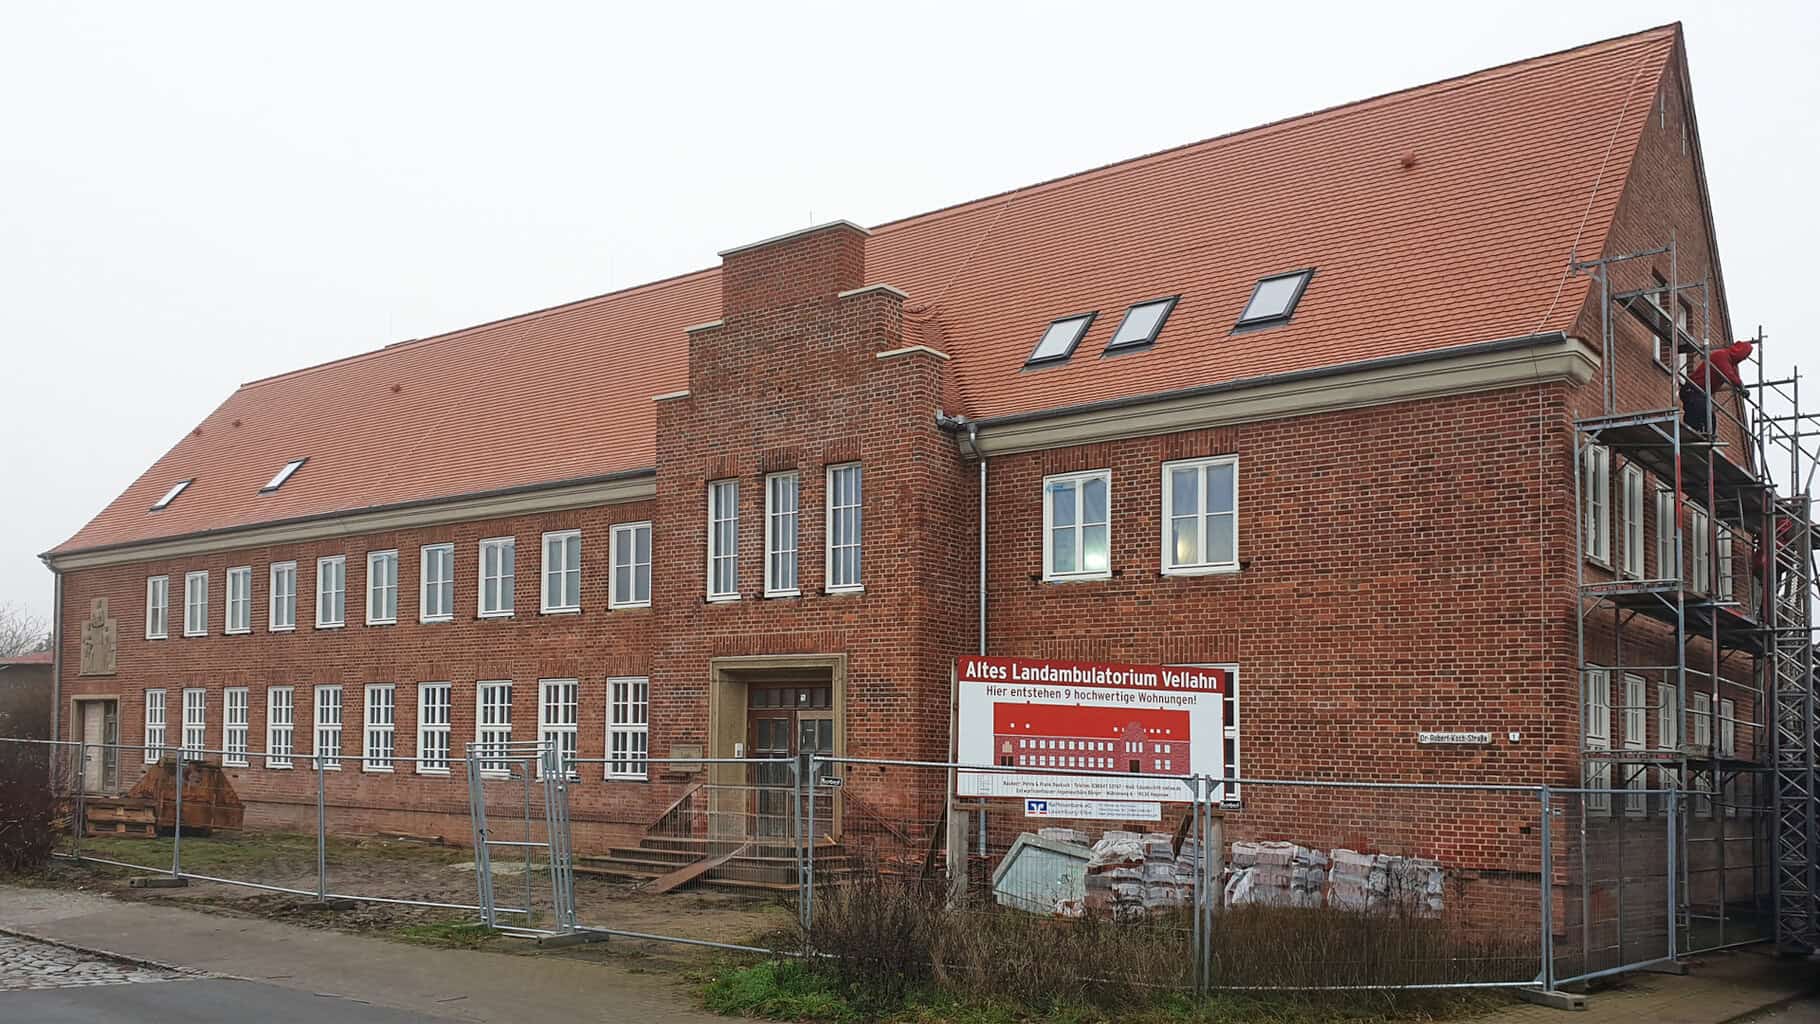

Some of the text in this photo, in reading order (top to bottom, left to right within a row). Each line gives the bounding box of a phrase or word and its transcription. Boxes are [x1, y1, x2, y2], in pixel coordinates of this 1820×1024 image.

[966, 661, 1217, 690] Altes Landambulatorium Vellahn
[986, 685, 1197, 706] Hier entstehen 9 hochwertige Wohnungen!
